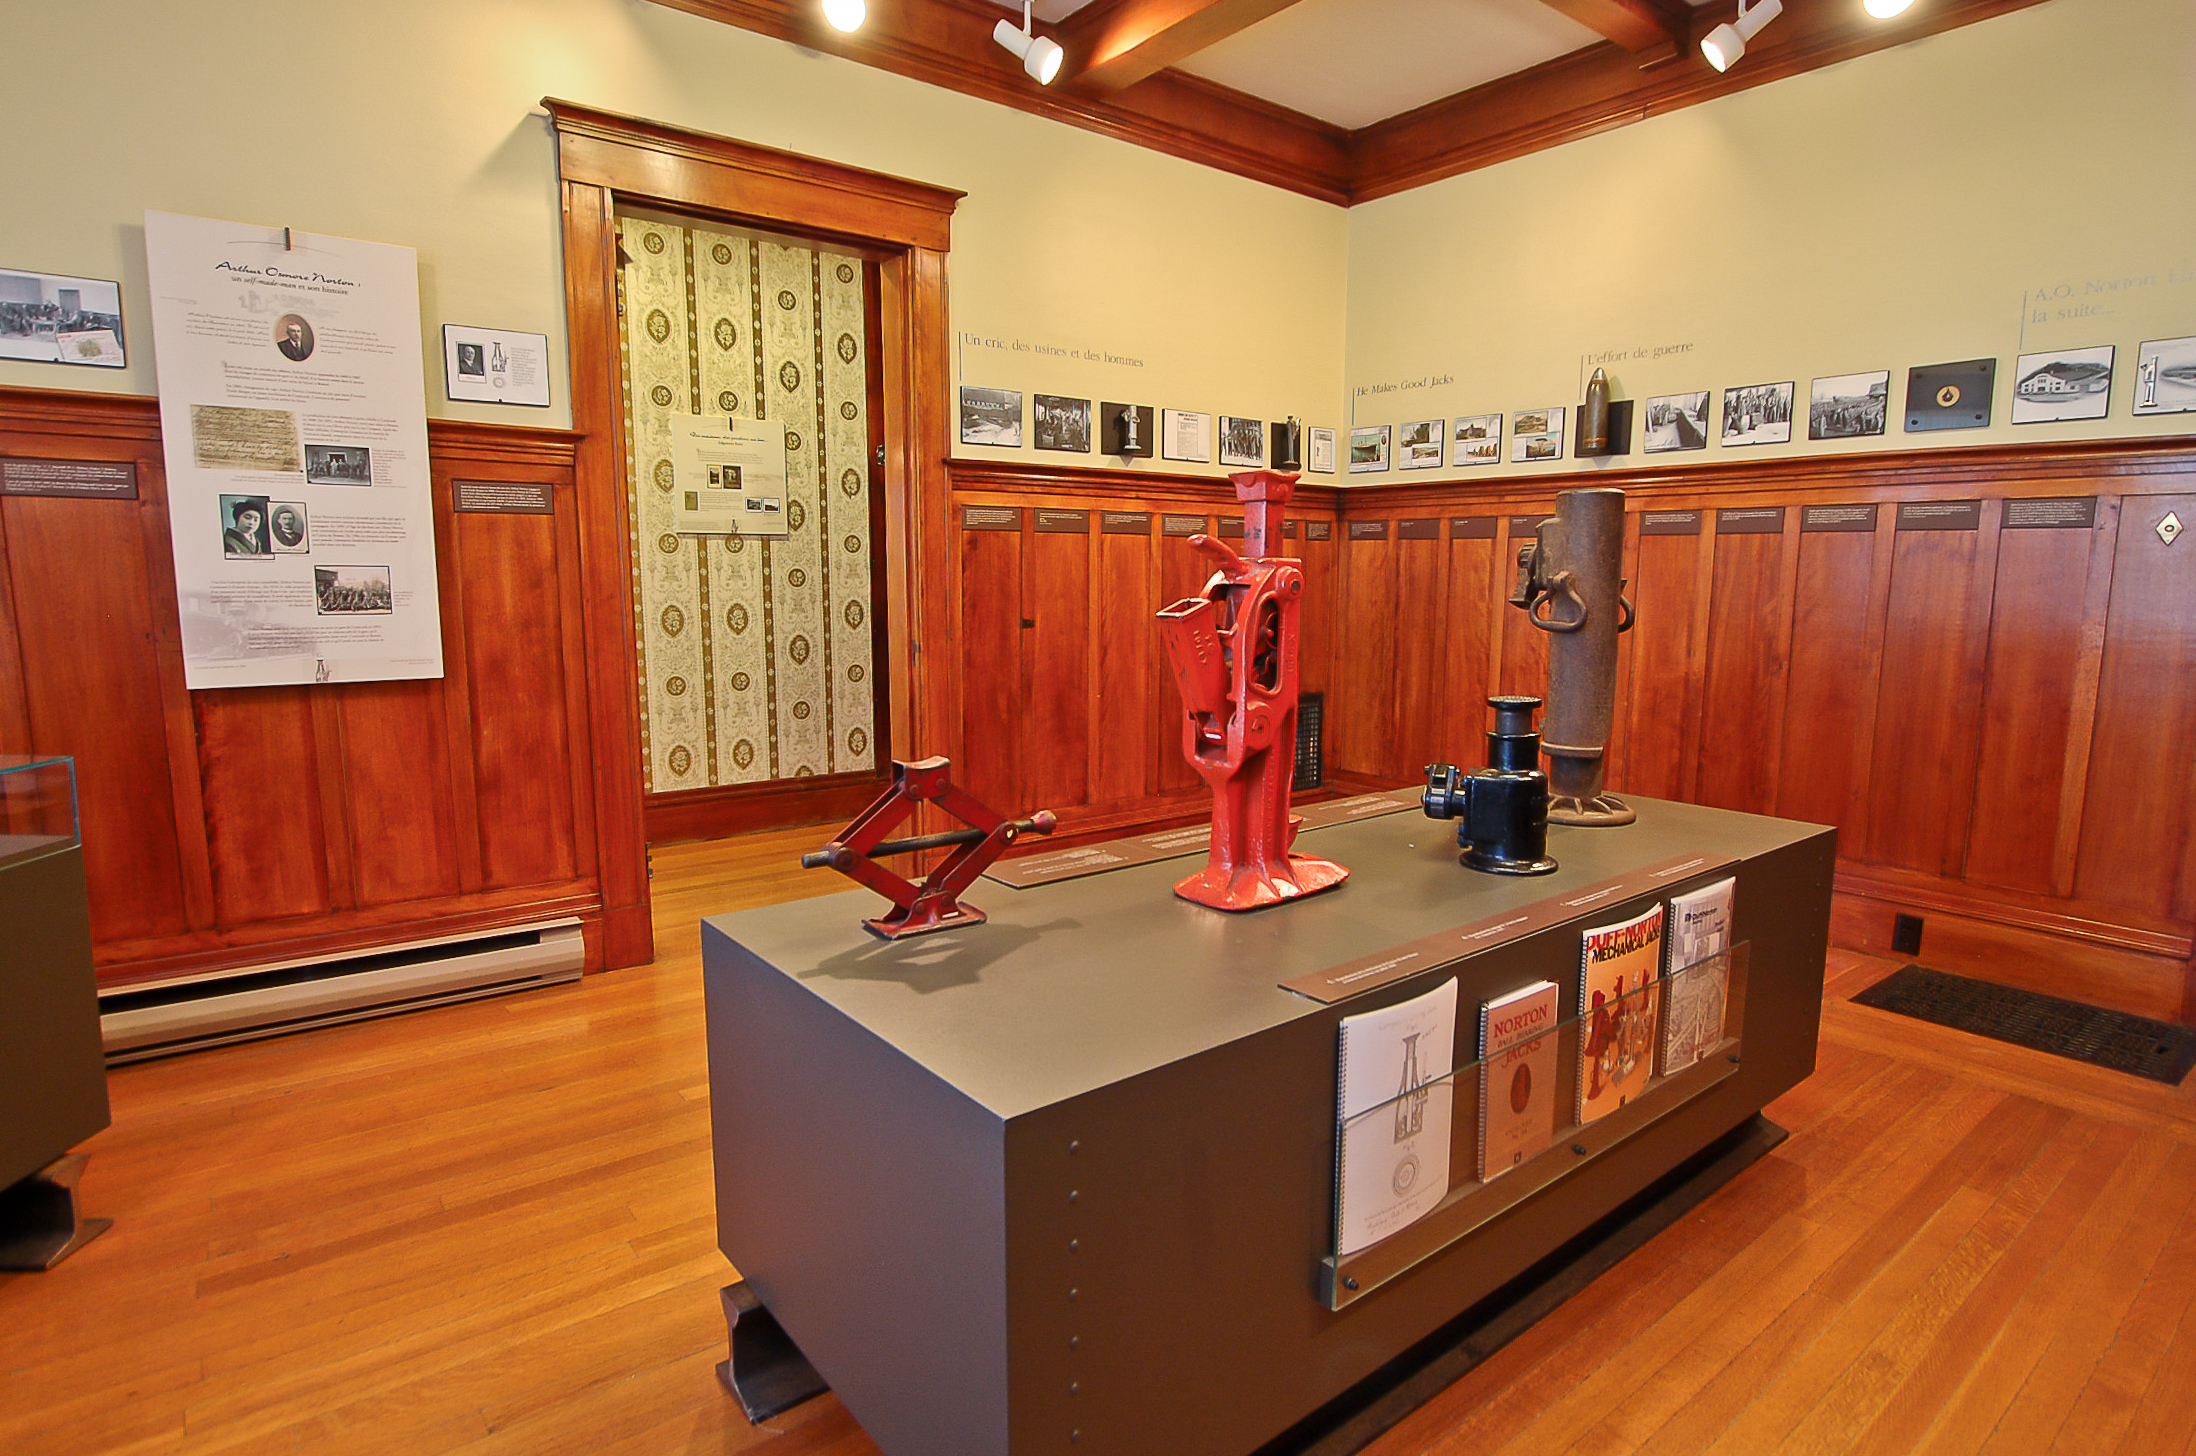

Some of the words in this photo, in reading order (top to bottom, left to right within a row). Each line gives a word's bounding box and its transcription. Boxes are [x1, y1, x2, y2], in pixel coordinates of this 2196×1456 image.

[215, 261, 264, 275] Arthur
[312, 273, 355, 287] Norton
[2034, 284, 2075, 302] A.O.
[2082, 274, 2156, 296] Norton
[2032, 308, 2047, 323] la
[964, 333, 981, 346] Un
[985, 336, 1008, 351] cric,
[1012, 339, 1031, 352] des
[1034, 343, 1067, 357] usines
[1070, 350, 1080, 358] et
[1083, 349, 1101, 361] des
[1104, 351, 1144, 367] hommes
[1587, 351, 1628, 366] L'effort
[1633, 347, 1648, 359] de
[1652, 342, 1694, 360] guerre
[1356, 386, 1369, 397] He
[1371, 381, 1398, 395] Makes
[1400, 376, 1427, 391] Good
[1429, 374, 1455, 389] Jacks
[1592, 932, 1645, 964] MECHANICAL
[1494, 1003, 1549, 1038] NORTON
[1501, 1037, 1542, 1068] JACKS
